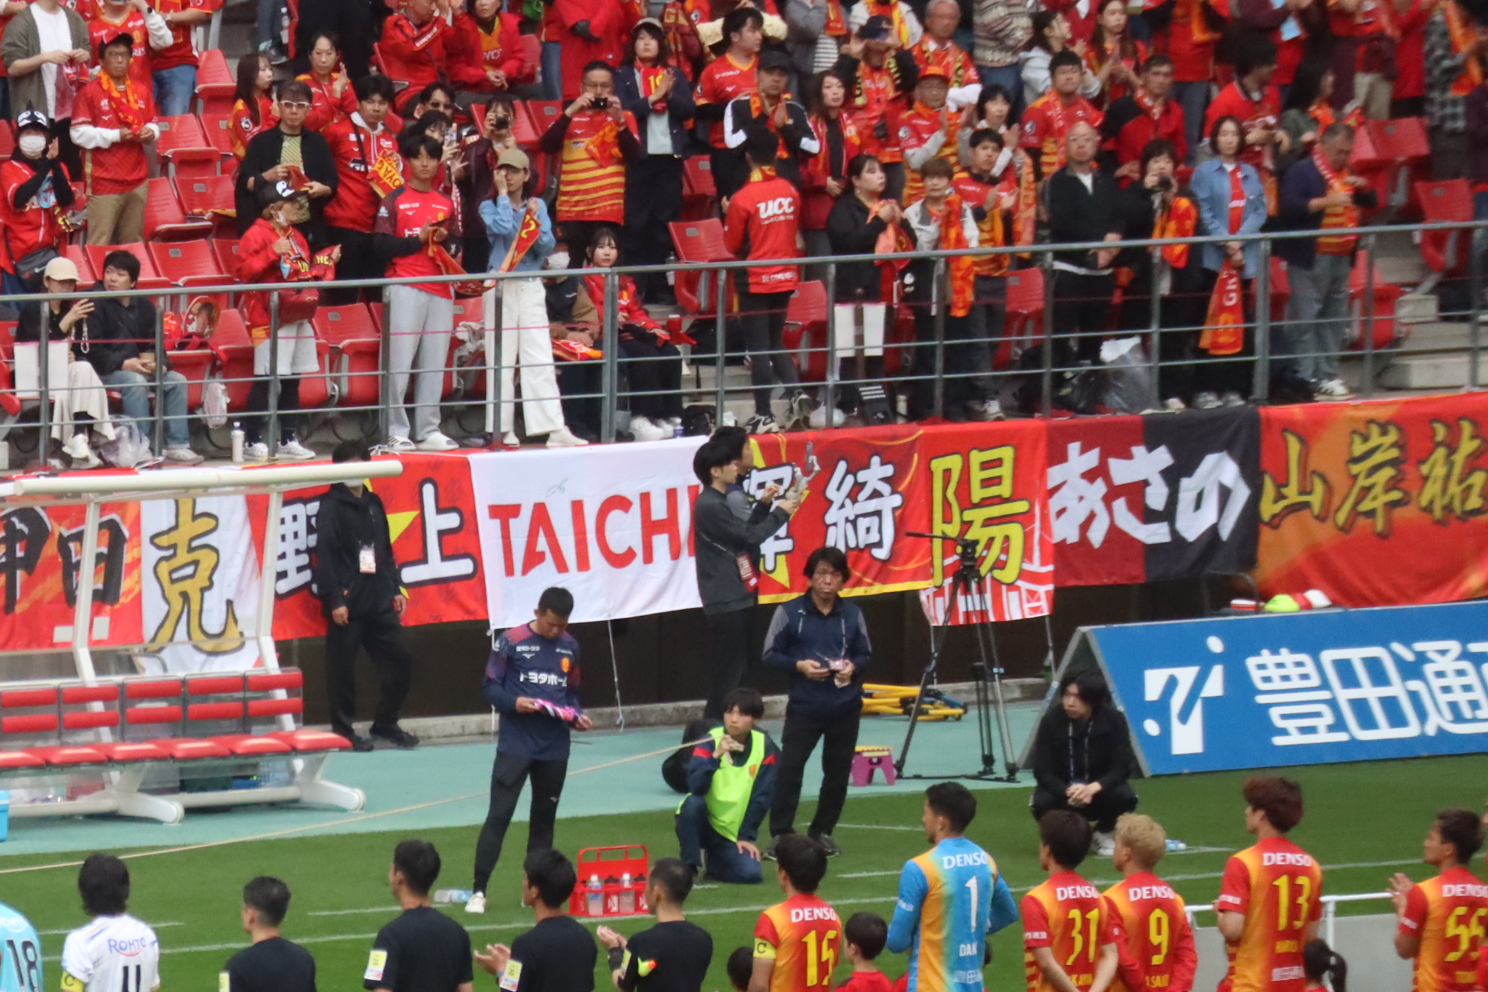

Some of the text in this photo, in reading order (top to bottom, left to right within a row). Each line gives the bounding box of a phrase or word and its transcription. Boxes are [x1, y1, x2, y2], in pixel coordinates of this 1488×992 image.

[931, 446, 1030, 588] 陽
[1047, 441, 1250, 549] あさの
[1245, 640, 1488, 746] 豊田通
[1263, 852, 1313, 867] DENSO
[791, 907, 837, 922] DENSO
[965, 875, 978, 933] 1
[1129, 886, 1175, 901] DENSO
[1272, 874, 1311, 931] 13
[802, 930, 838, 987] 15
[1065, 908, 1101, 966] 31
[1149, 908, 1169, 966] 9
